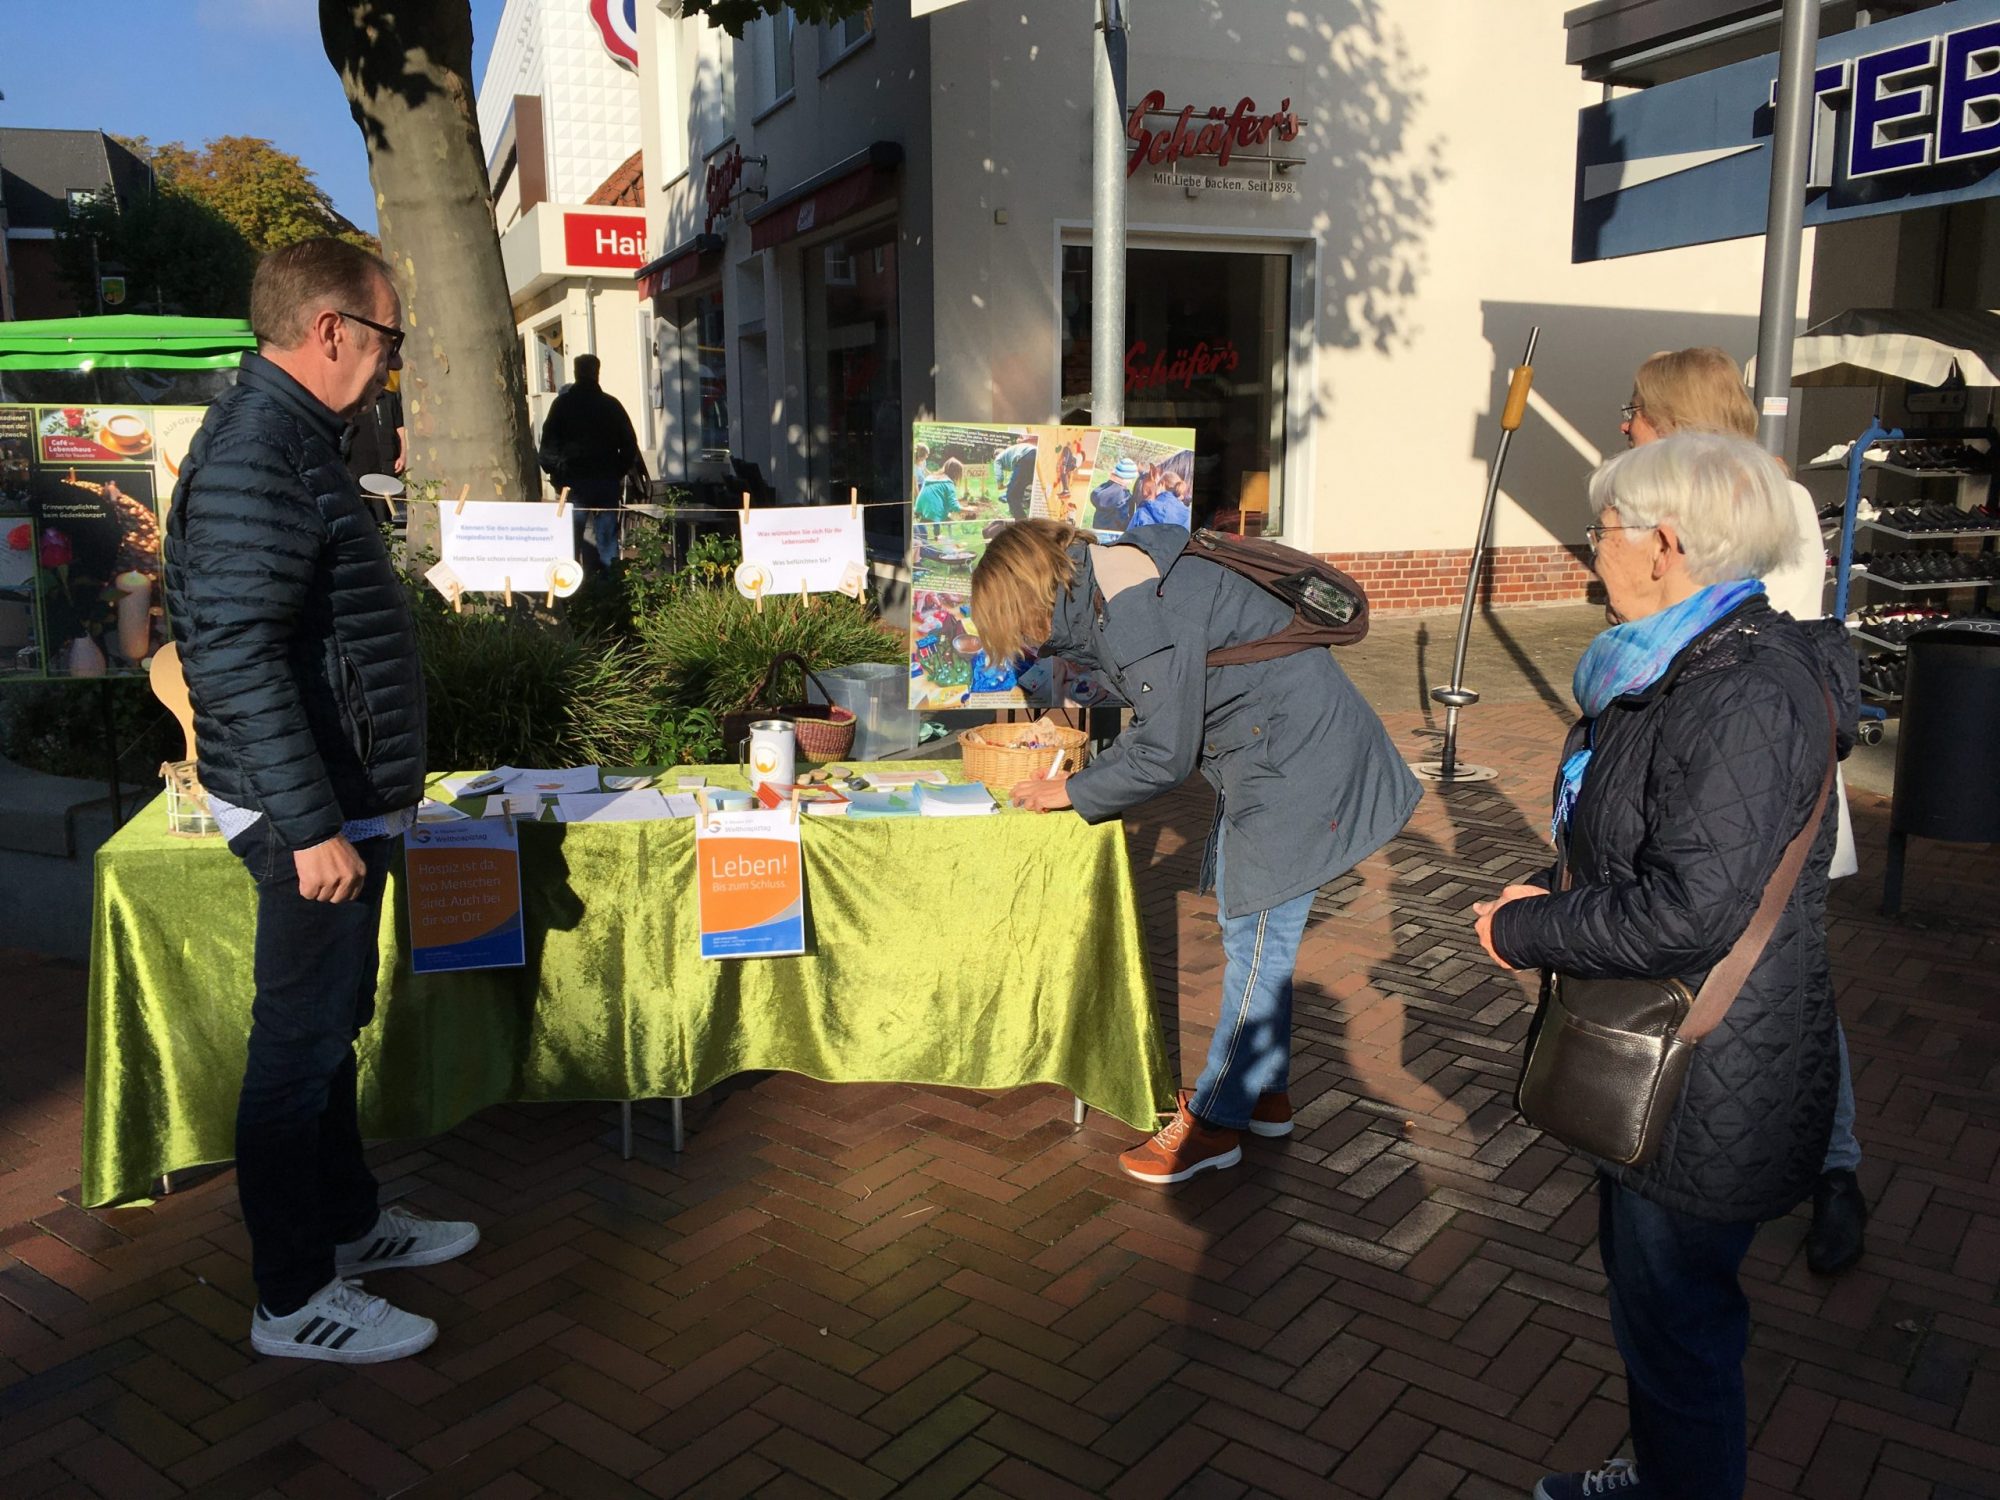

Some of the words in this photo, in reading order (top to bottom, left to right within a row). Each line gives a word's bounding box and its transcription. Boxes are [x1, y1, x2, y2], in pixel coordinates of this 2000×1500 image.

[1127, 89, 1299, 178] Schäfer's
[1153, 173, 1173, 185] Mit
[1175, 174, 1201, 187] Liebe
[1205, 176, 1245, 191] backen.
[1247, 180, 1267, 192] Seit
[1268, 182, 1296, 194] 1898.
[595, 228, 647, 256] Hai
[418, 863, 459, 875] Hospiz
[462, 862, 477, 872] ist
[711, 854, 788, 878] Leben!
[419, 884, 438, 892] wo
[441, 877, 501, 891] Menschen
[712, 882, 726, 892] Bis
[728, 883, 749, 891] zum
[450, 895, 480, 907] Auch
[483, 893, 501, 904] bei
[423, 915, 438, 926] dir
[442, 915, 459, 925] vor
